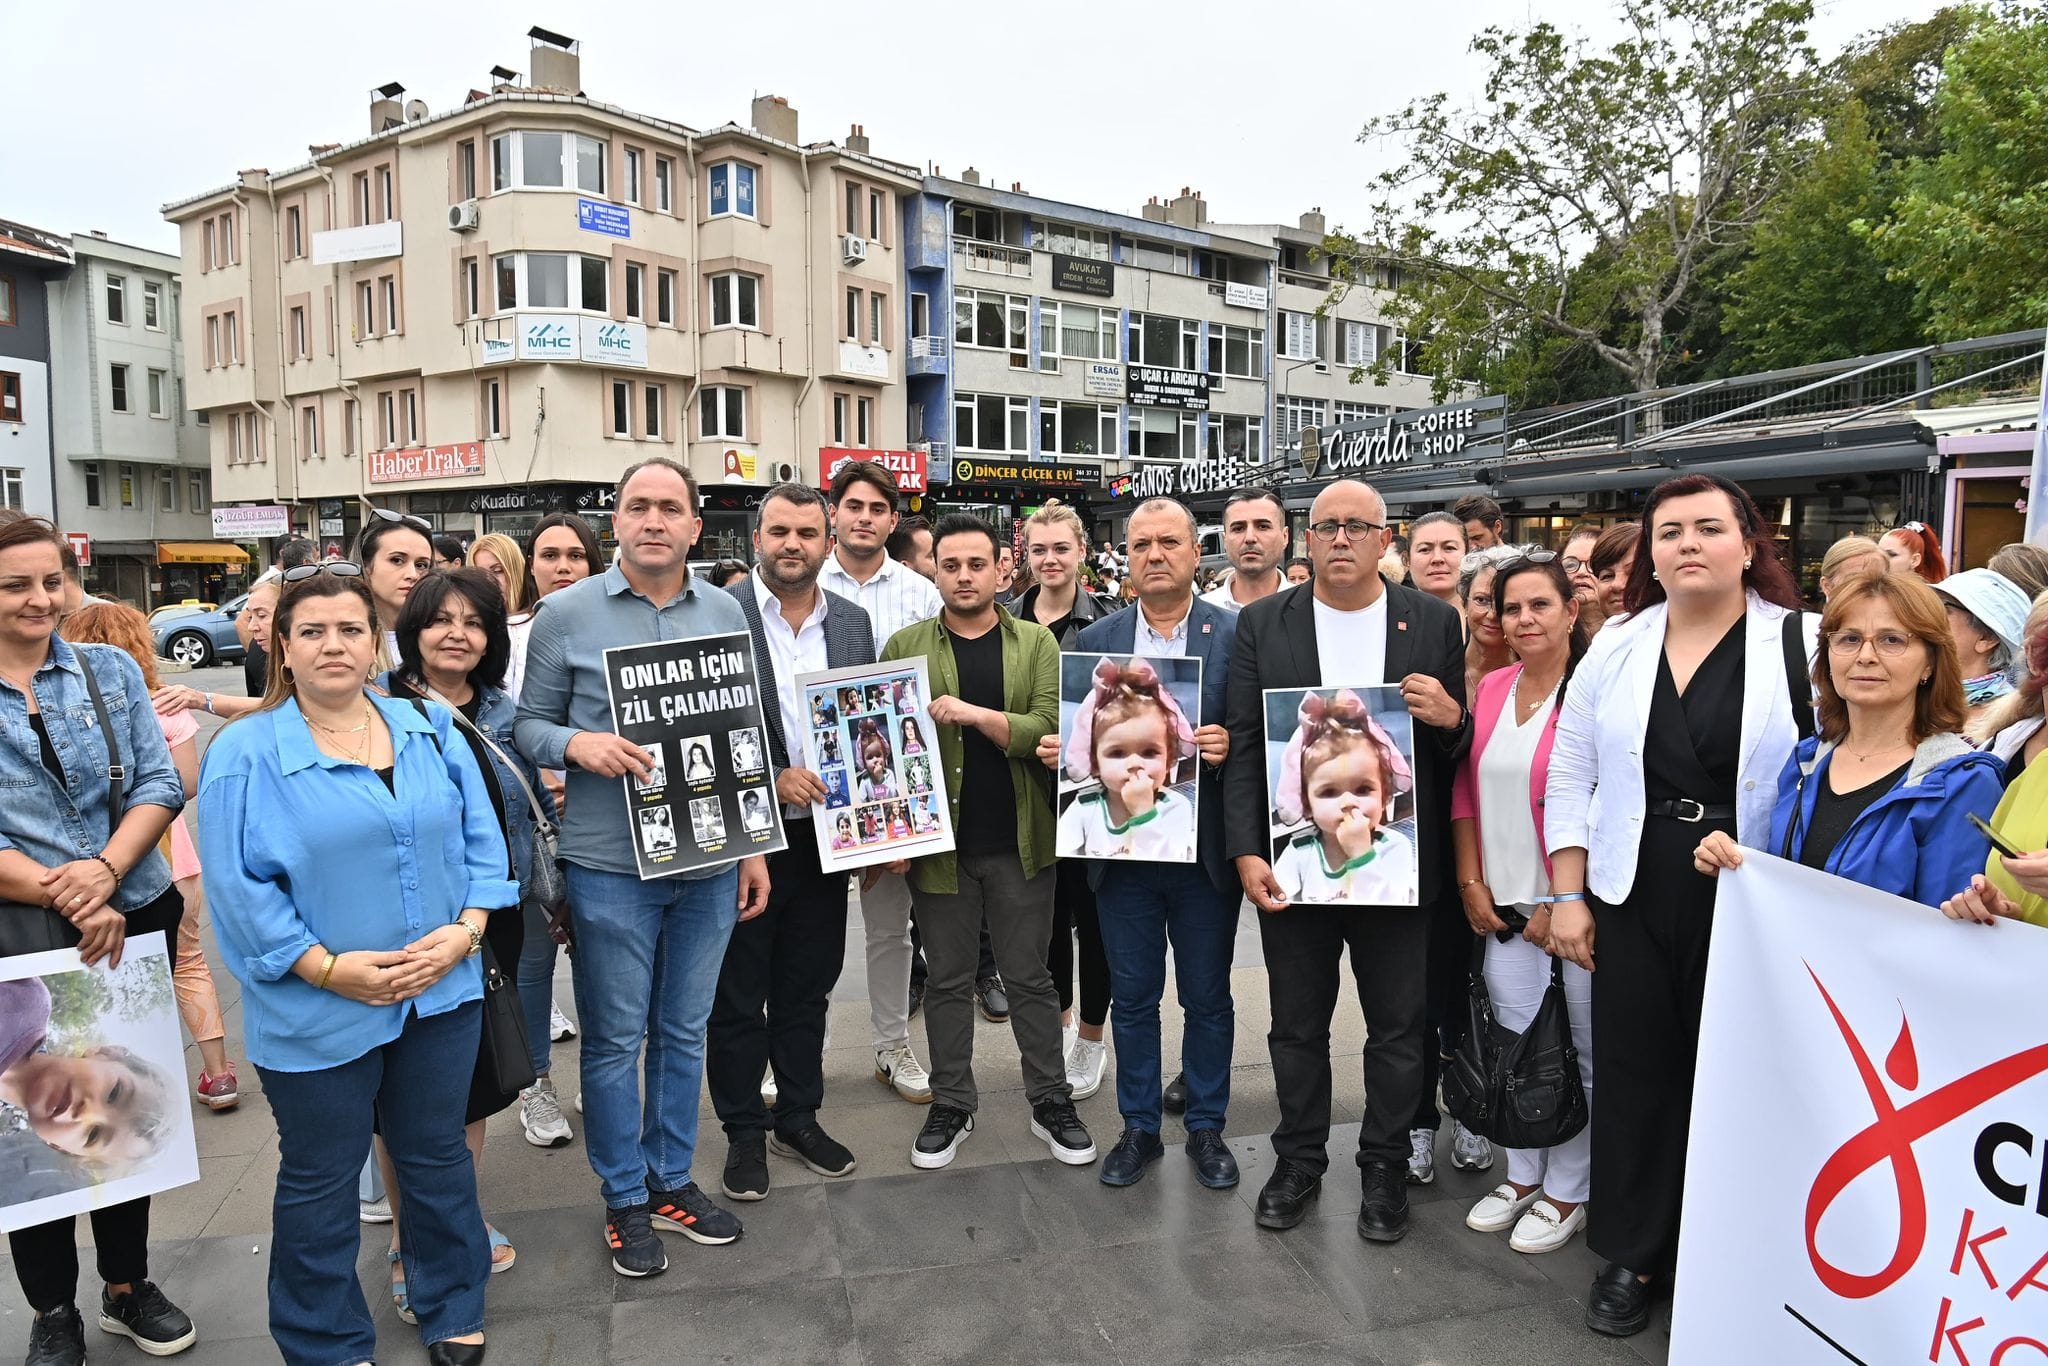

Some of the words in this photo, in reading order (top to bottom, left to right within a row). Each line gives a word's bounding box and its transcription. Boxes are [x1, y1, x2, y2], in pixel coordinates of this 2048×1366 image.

[1062, 272, 1083, 282] ERDEM
[1069, 261, 1101, 275] AVUKAT
[527, 337, 571, 348] MHC
[599, 337, 631, 350] MHC
[1141, 368, 1161, 383] UÇAR
[1163, 371, 1169, 382] &
[1170, 373, 1198, 387] ARICAN
[1418, 408, 1473, 434] COFFEE
[1327, 417, 1409, 471] Cuerda
[1424, 433, 1466, 456] SHOP
[975, 464, 1018, 480] DİNÇER
[1021, 466, 1053, 481] ÇİÇEK
[1056, 468, 1073, 481] EVİ
[1132, 468, 1173, 498] GANOS
[1180, 456, 1238, 493] COFFEE
[481, 493, 526, 509] Kuaför
[620, 658, 695, 690] ONLAR
[699, 648, 745, 684] İÇİN
[621, 695, 656, 726] ZİL
[660, 684, 754, 726] ÇALMADI
